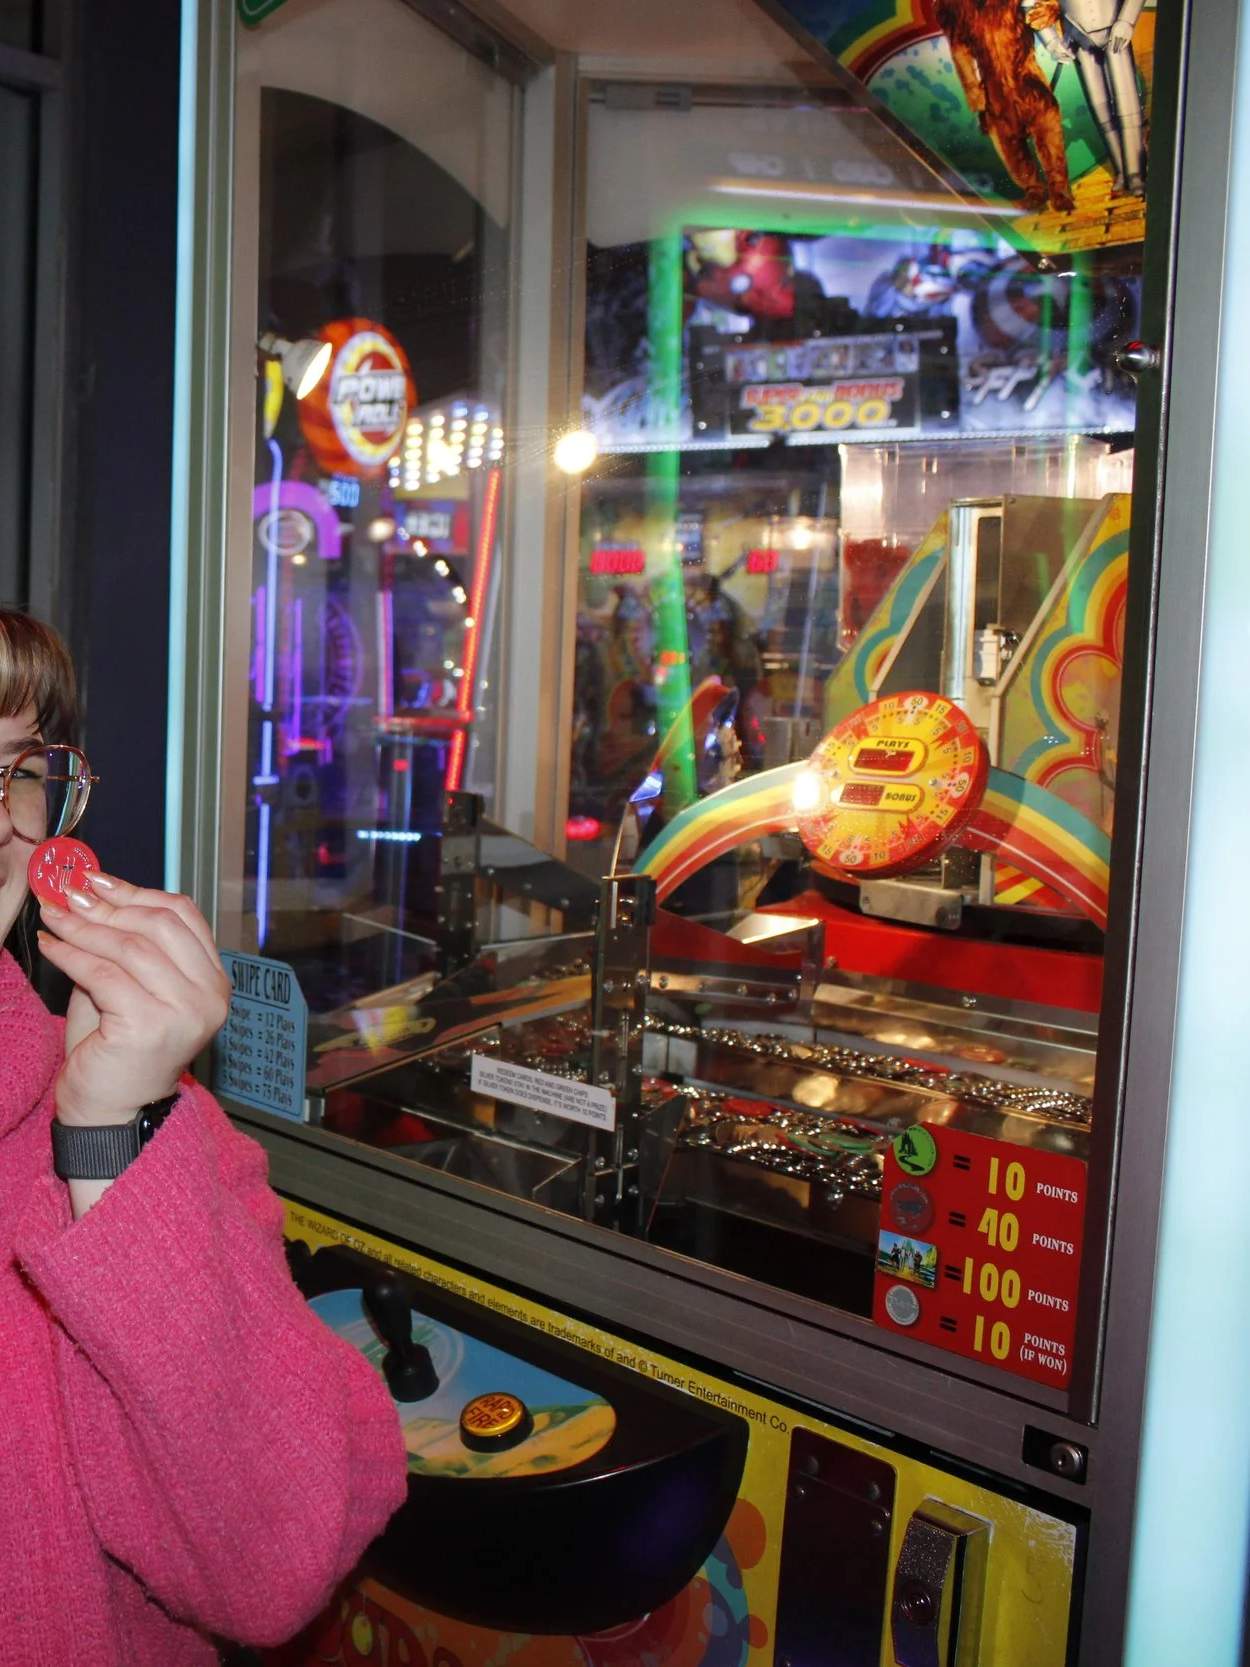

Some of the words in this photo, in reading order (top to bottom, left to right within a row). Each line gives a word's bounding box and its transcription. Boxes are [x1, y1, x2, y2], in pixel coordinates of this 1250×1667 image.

[935, 704, 947, 714] 15
[876, 740, 910, 749] PLAYS
[885, 791, 917, 802] BONUS
[955, 780, 967, 792] 50
[844, 854, 857, 864] 50
[231, 959, 261, 997] SWIPE
[264, 968, 292, 1005] CARD
[276, 1014, 295, 1035] Plays
[276, 1033, 296, 1053] Plays
[276, 1051, 295, 1071] Plays
[275, 1069, 295, 1089] Plays
[274, 1086, 293, 1107] Plays
[988, 1157, 1025, 1201] 10
[1036, 1182, 1078, 1203] POINTS
[978, 1207, 1019, 1252] 40
[1032, 1233, 1074, 1255] POINTS
[963, 1256, 1021, 1309] 100
[1027, 1289, 1070, 1312] POINTS
[290, 1211, 306, 1228] THE
[307, 1219, 339, 1241] WIZARD
[367, 1247, 382, 1261] and
[424, 1269, 467, 1297] characters
[469, 1288, 486, 1304] and
[487, 1297, 528, 1322] elements
[530, 1315, 546, 1329] are
[548, 1321, 602, 1354] trademarks
[604, 1347, 615, 1358] of
[617, 1353, 636, 1368] and
[650, 1363, 685, 1388] Turner
[688, 1380, 767, 1425] Entertainment
[770, 1415, 790, 1435] Co.
[973, 1315, 1010, 1360] 10
[1024, 1332, 1066, 1356] POINTS
[1019, 1344, 1036, 1362] (IF
[1038, 1354, 1068, 1376] WON)
[467, 1406, 500, 1429] FIRE
[480, 1396, 516, 1420] RAPID
